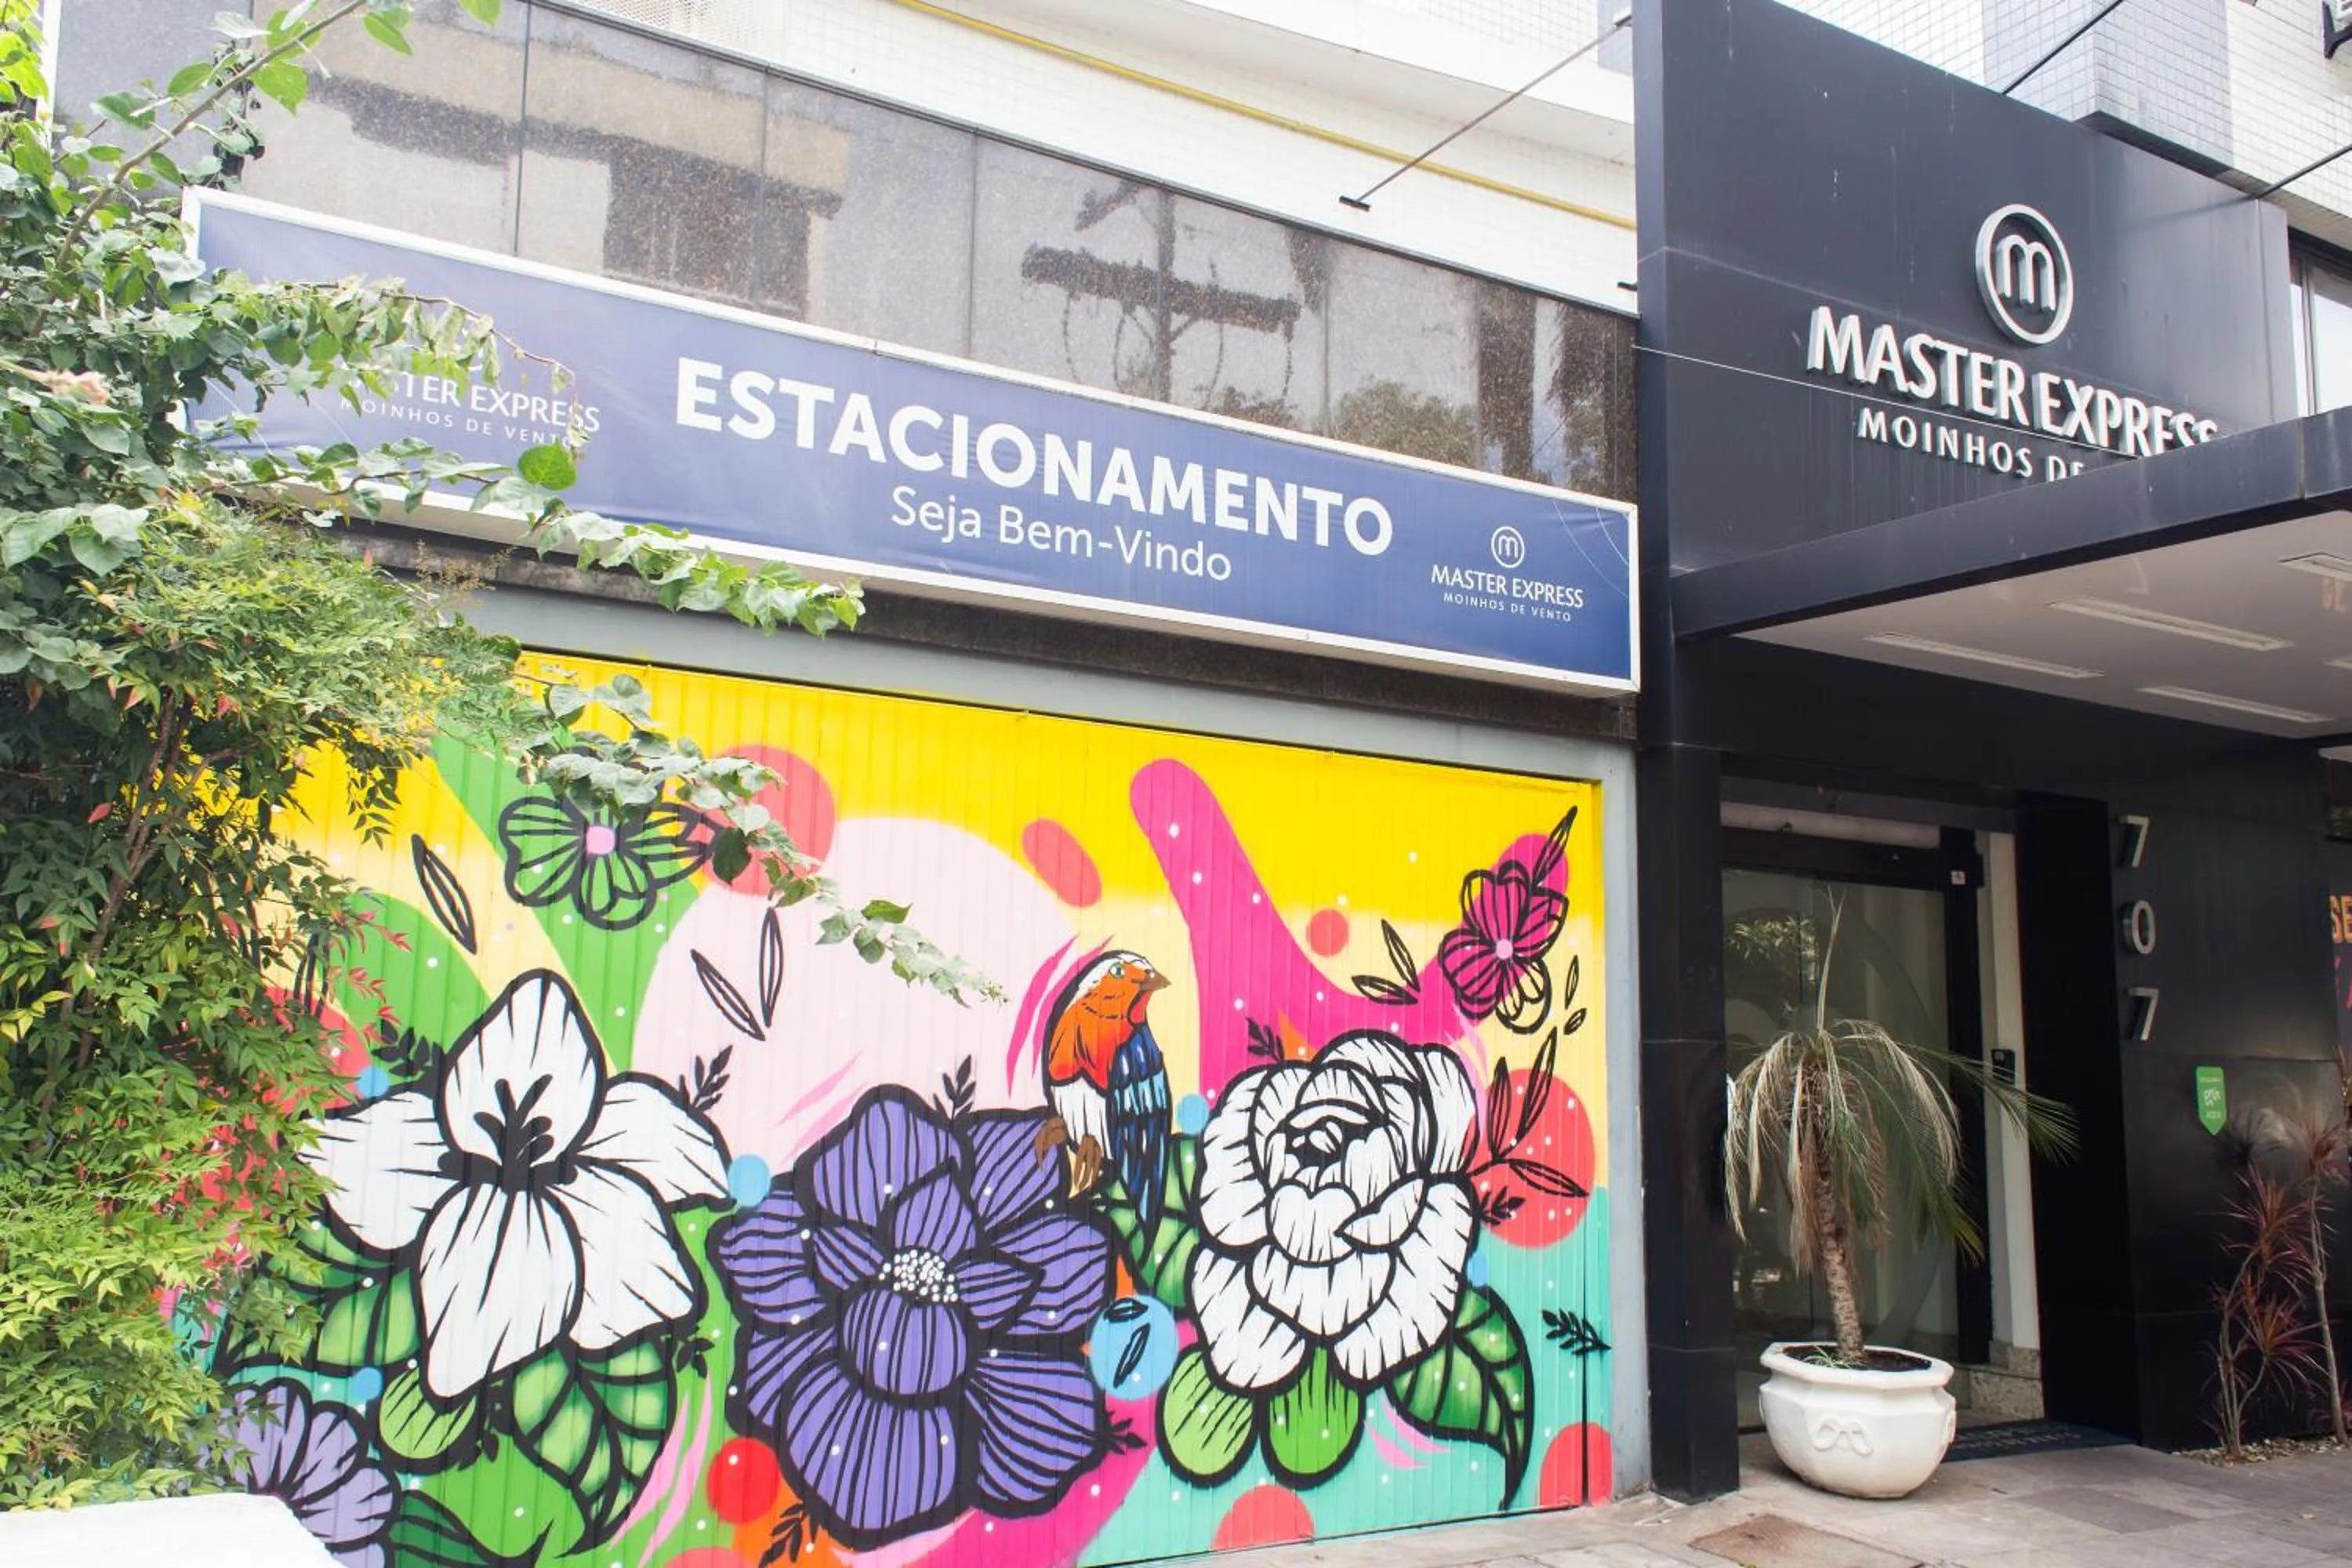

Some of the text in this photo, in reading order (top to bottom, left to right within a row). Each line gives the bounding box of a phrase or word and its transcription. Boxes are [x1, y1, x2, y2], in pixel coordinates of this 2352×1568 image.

[1806, 306, 2029, 426] MASTER
[466, 418, 493, 436] DE
[470, 384, 600, 432] EXPRESS
[677, 357, 1393, 556] ESTACIONAMENTO
[1857, 408, 2032, 477] MOINHOS
[891, 485, 1232, 581] Seja Bem-Vindo
[1431, 564, 1584, 608] MASTER EXPRESS
[1443, 592, 1571, 622] MOINHOS DE VENTO
